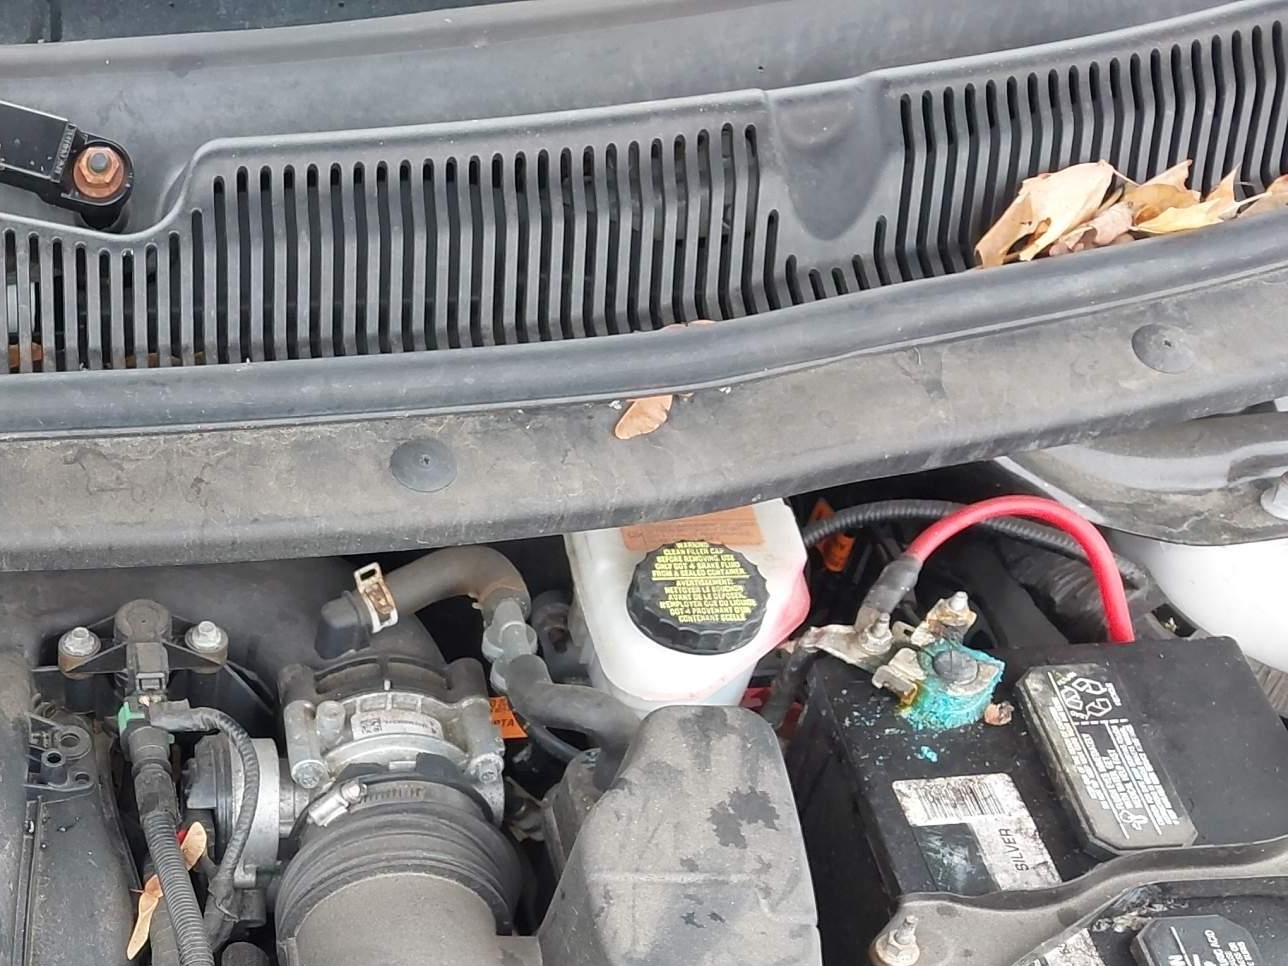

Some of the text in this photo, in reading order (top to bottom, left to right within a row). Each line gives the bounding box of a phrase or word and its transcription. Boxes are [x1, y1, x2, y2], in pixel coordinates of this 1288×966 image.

[663, 548, 686, 556] CLEAN
[710, 547, 724, 555] CAP
[720, 561, 741, 569] FLUID
[652, 569, 673, 577] FROM
[999, 828, 1029, 872] SILVER
[1204, 929, 1221, 947] ACID
